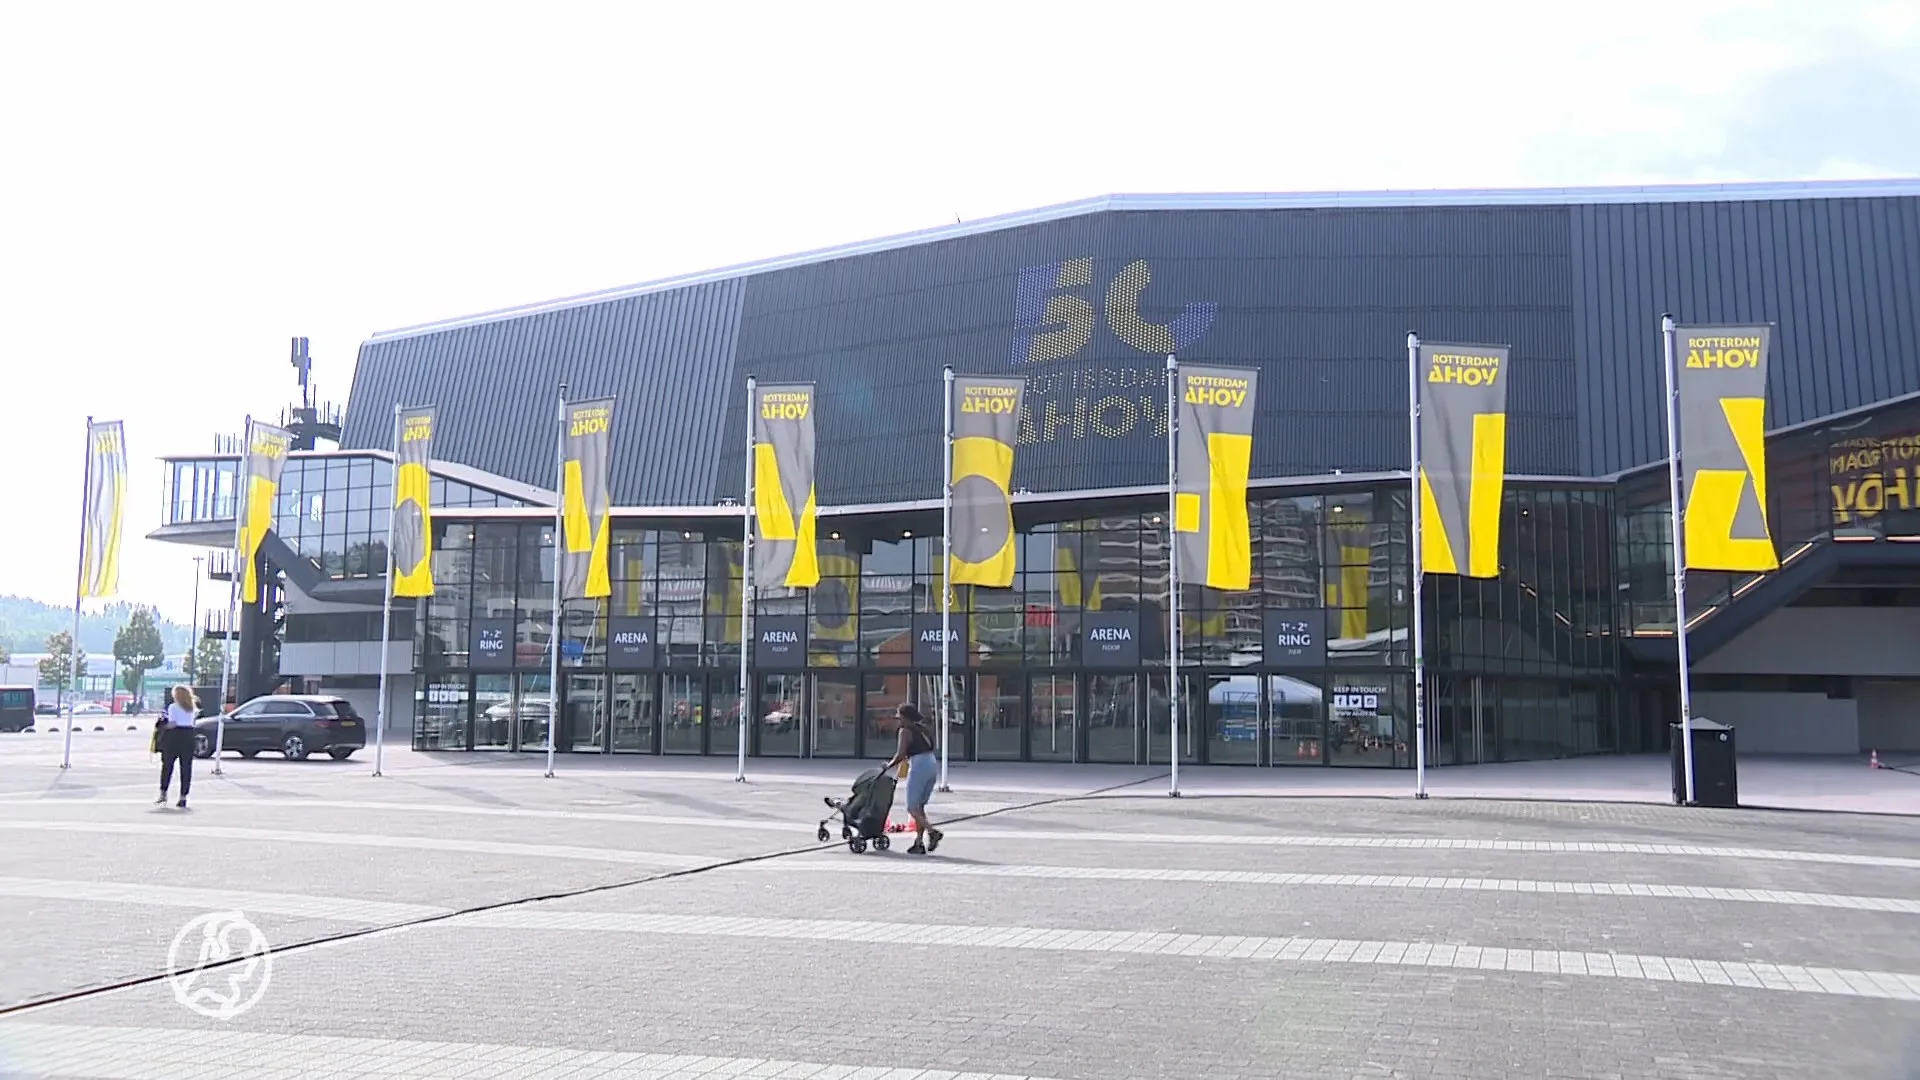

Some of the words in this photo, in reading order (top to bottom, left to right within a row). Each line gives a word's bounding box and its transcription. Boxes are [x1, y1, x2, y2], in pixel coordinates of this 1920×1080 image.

[1689, 336, 1760, 348] ROTTERDAM
[1432, 354, 1499, 367] ROTTERDAM
[1686, 349, 1758, 368] AHOY
[1187, 375, 1248, 388] ROTTERDAM
[1428, 365, 1498, 386] AHOY
[964, 386, 1017, 396] ROTTERDAM
[1184, 386, 1247, 407] AHOY
[762, 403, 809, 420] AHOY
[961, 397, 1016, 414] AHOY
[570, 417, 608, 437] AHOY
[614, 632, 648, 644] ARENA
[762, 631, 798, 643] ARENA
[1090, 628, 1131, 641] ARENA
[1278, 634, 1311, 646] RING
[480, 640, 504, 650] RING
